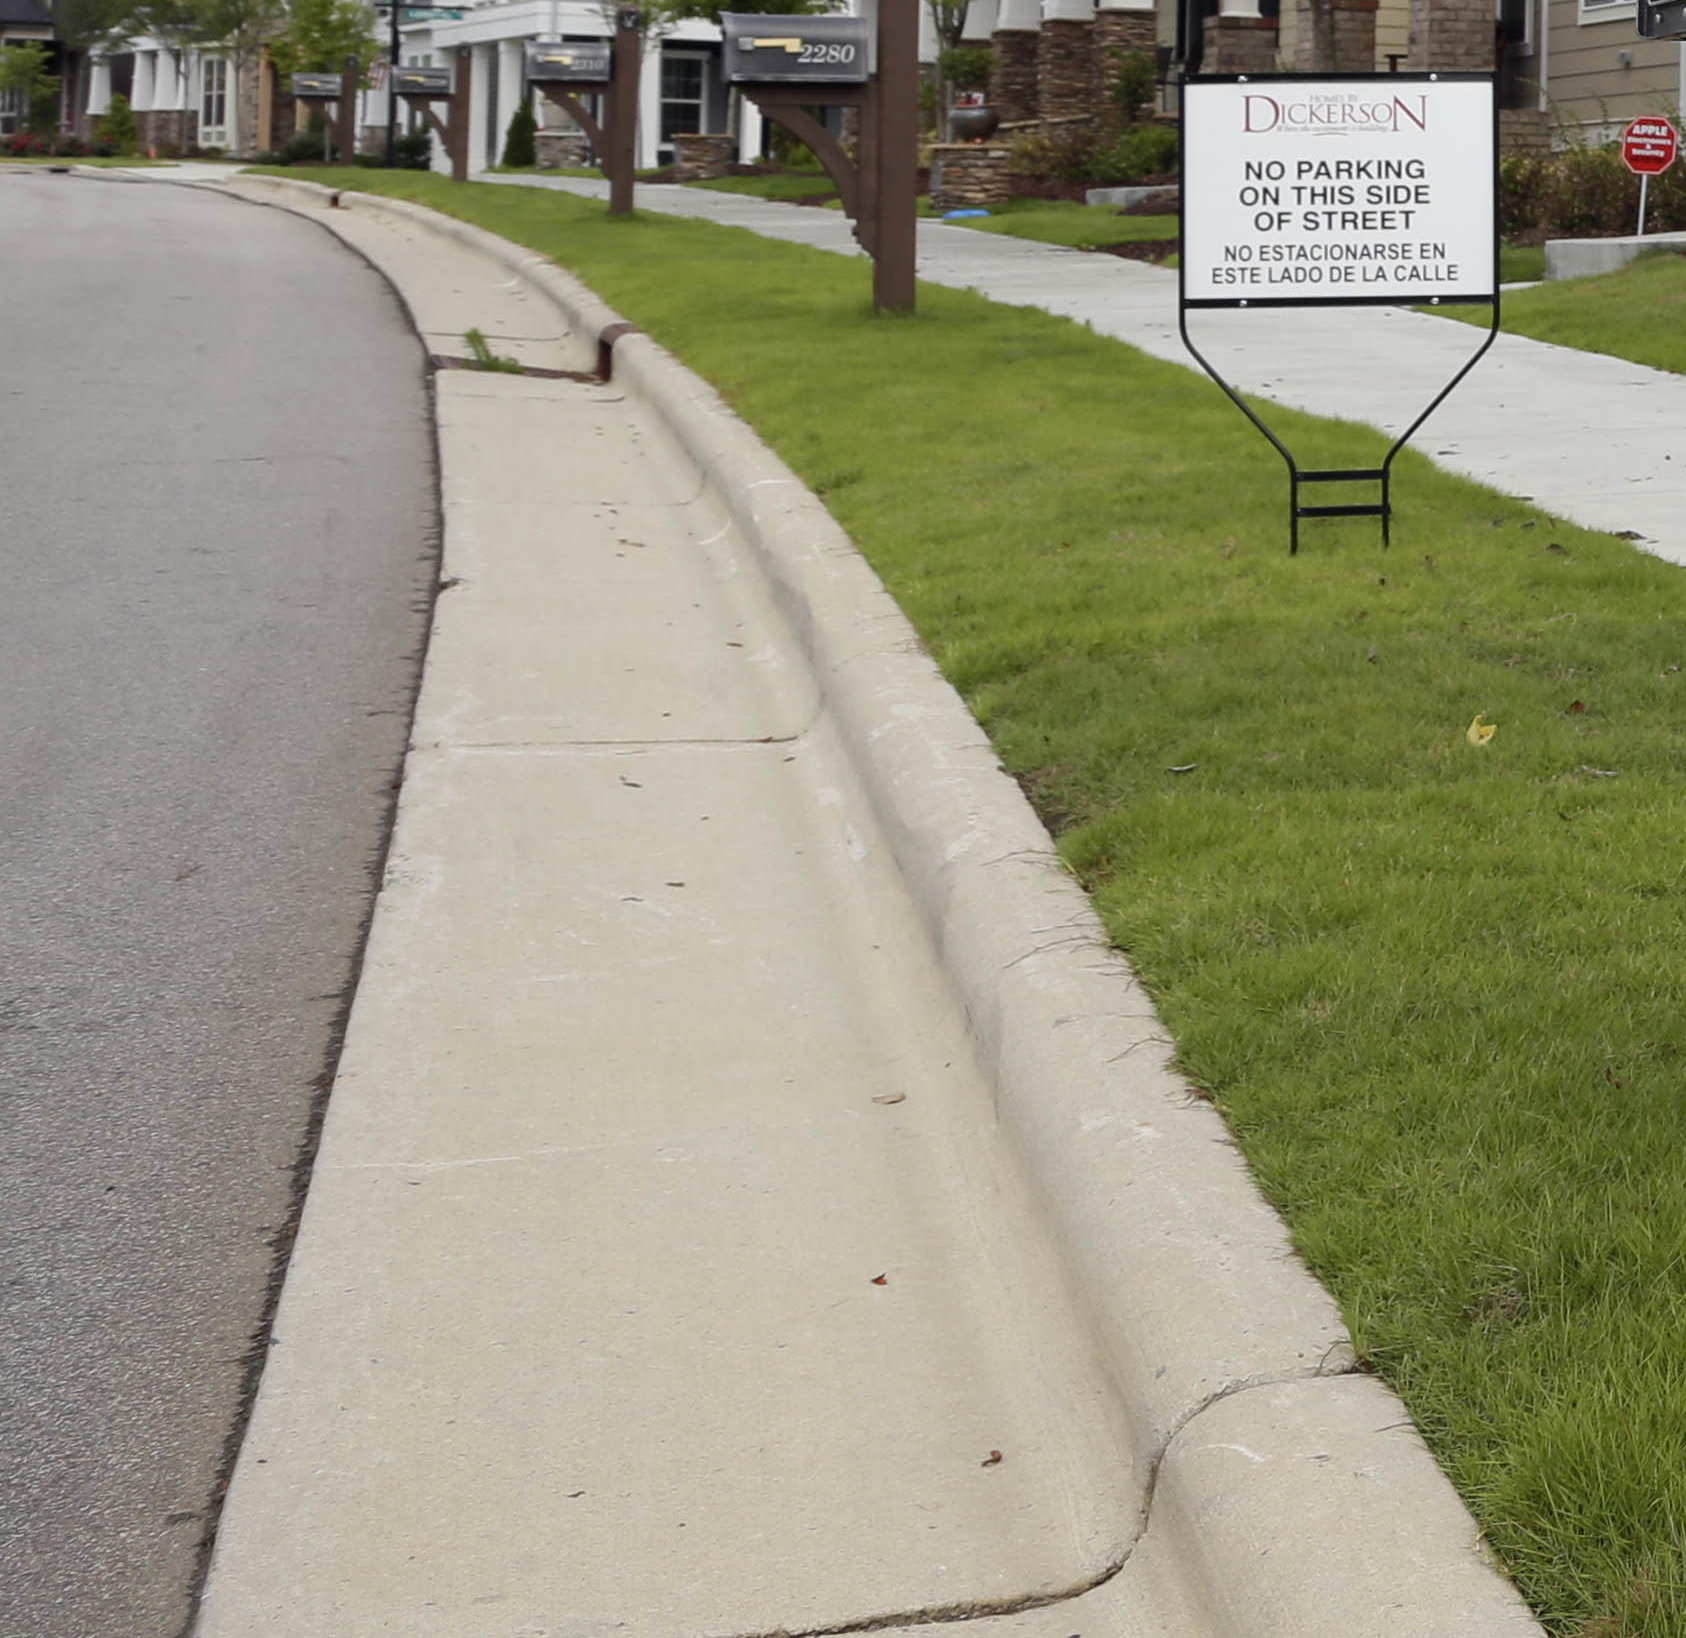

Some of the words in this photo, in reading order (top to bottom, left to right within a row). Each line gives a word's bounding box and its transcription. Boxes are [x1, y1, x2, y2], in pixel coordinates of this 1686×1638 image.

[797, 44, 855, 63] 2280
[1242, 94, 1429, 133] DICKERSON
[1632, 125, 1668, 136] APPLE
[1244, 161, 1285, 181] NO
[1296, 159, 1426, 180] PARKING
[1239, 187, 1280, 206] ON
[1290, 186, 1355, 206] THIS
[1366, 185, 1431, 205] SIDE
[1254, 212, 1292, 232] OF
[1302, 210, 1416, 231] STREET
[1224, 245, 1252, 262] NO
[1259, 243, 1412, 262] ESTACIONARSE
[1420, 242, 1446, 259] EN
[1212, 267, 1261, 284] ESTE
[1268, 266, 1323, 284] LADO
[1329, 266, 1355, 283] DE
[1362, 265, 1388, 282] LA
[1394, 264, 1459, 282] CALLE
